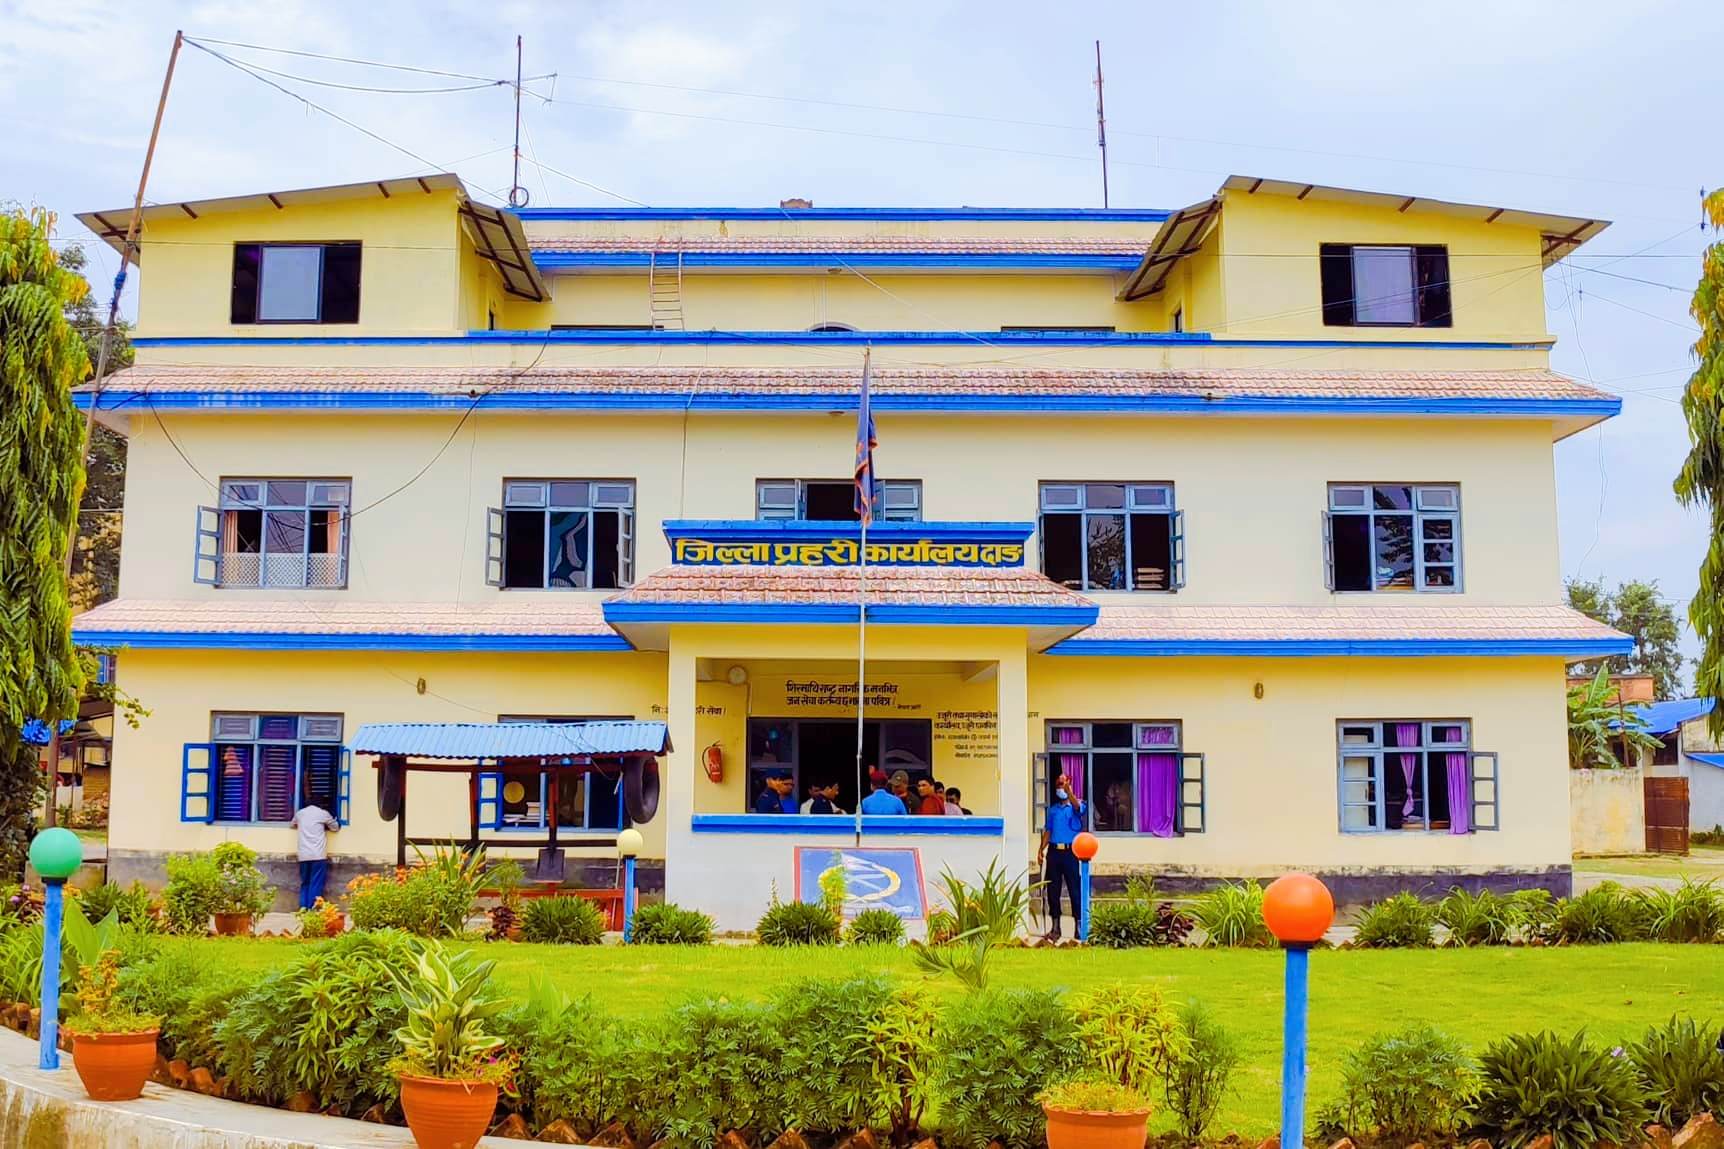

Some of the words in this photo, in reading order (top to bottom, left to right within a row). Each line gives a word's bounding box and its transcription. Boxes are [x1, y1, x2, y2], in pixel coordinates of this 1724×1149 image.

[675, 538, 770, 564] जिल्ला
[774, 539, 860, 565] प्रहरी
[864, 540, 978, 564] कार्यालय
[980, 544, 1023, 565] दाङ
